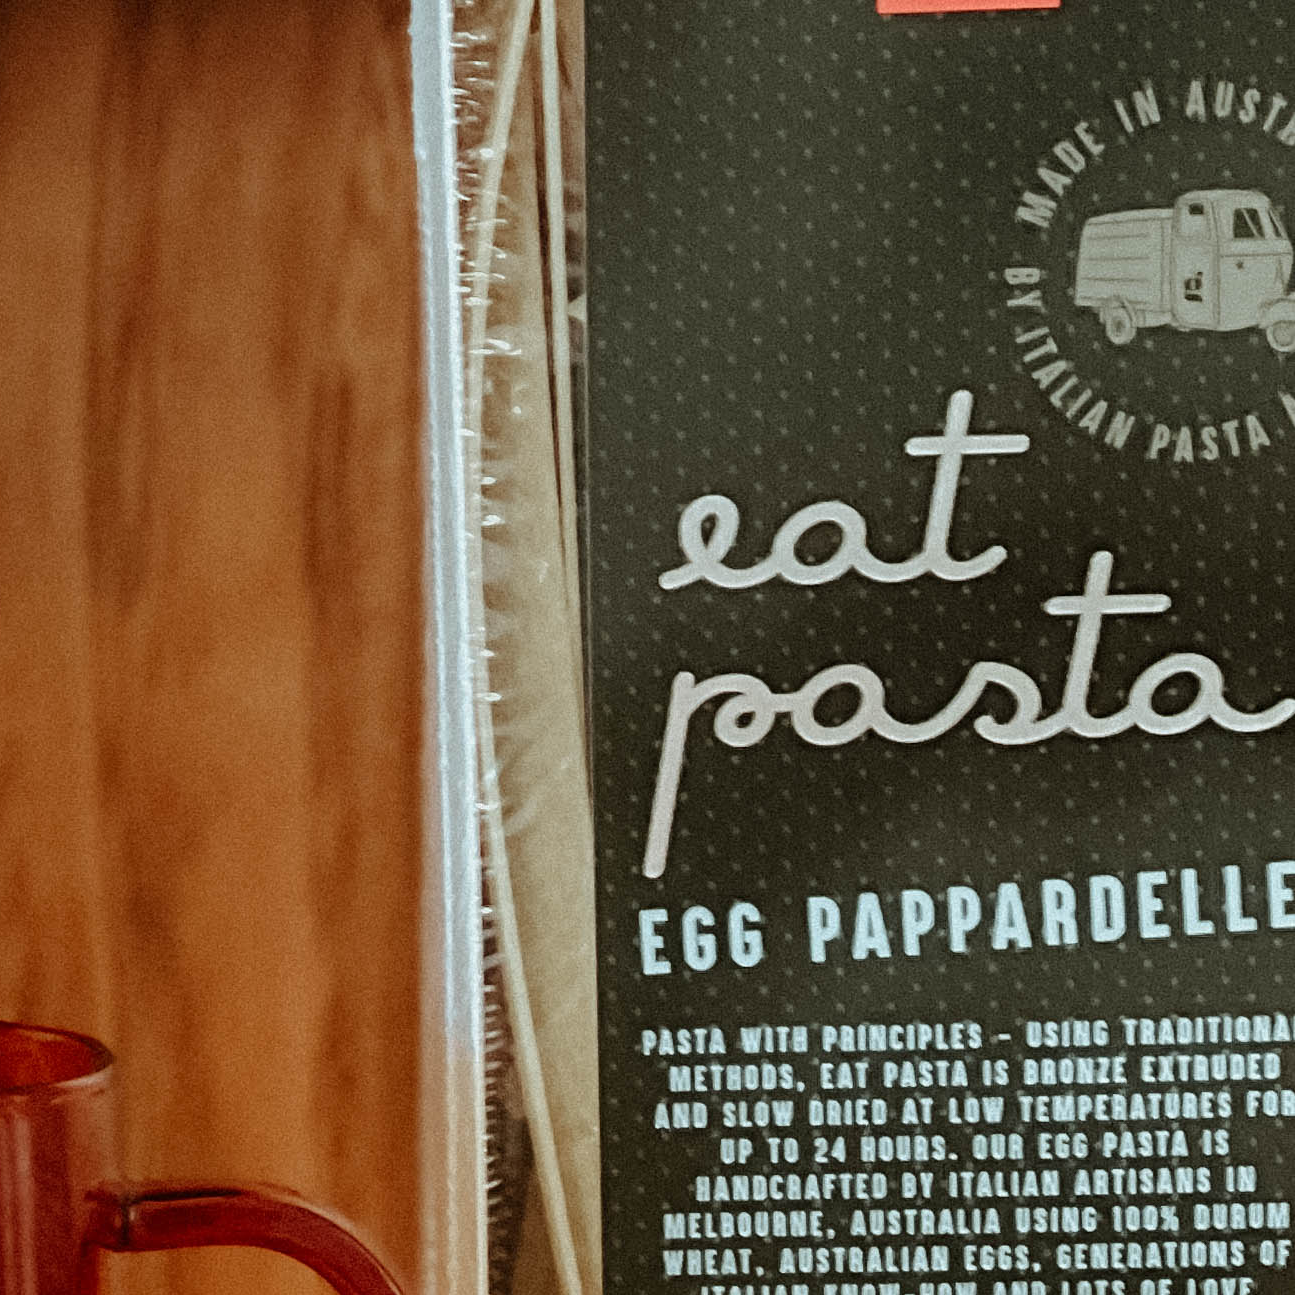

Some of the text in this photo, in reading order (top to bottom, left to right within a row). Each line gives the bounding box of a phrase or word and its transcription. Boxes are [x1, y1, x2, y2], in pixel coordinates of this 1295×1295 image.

[1013, 120, 1105, 229] MADE
[1113, 86, 1161, 133] IN
[1004, 267, 1270, 463] BY ITALIAN PASTA
[658, 389, 1030, 590] eat
[643, 547, 1295, 883] pasta
[639, 860, 1295, 976] EGG PAPPARDELLE
[642, 1013, 1295, 1056] PASTA WITH PRINCIPLES - USING TRADITIONA
[820, 1061, 869, 1090] EAT
[883, 1060, 968, 1088] PASTA
[982, 1059, 1009, 1087] IS
[1023, 1054, 1128, 1086] BRONZE
[1141, 1052, 1281, 1083] EXTRUDED
[654, 1089, 1295, 1129] AND SLOW DRIED AT LOW TEMPERATURES FOR
[720, 1138, 753, 1165] UP
[766, 1137, 799, 1164] TO
[814, 1136, 846, 1163] 24
[972, 1133, 1024, 1160] OUR
[1038, 1132, 1088, 1160] EGG
[1102, 1129, 1189, 1158] PASTA
[1202, 1129, 1229, 1156] IS
[696, 1165, 1256, 1202] HANDCRAFTED BY ITALIAN ARTISANS IN
[850, 1207, 1001, 1236] AUSTRALIA
[1015, 1206, 1097, 1233] USING
[1112, 1205, 1179, 1231] 100%
[1194, 1202, 1290, 1229] DURUM
[779, 1245, 949, 1274] AUSTRALIAN
[1056, 1240, 1245, 1268] GENERATIONS
[1259, 1239, 1292, 1264] OF
